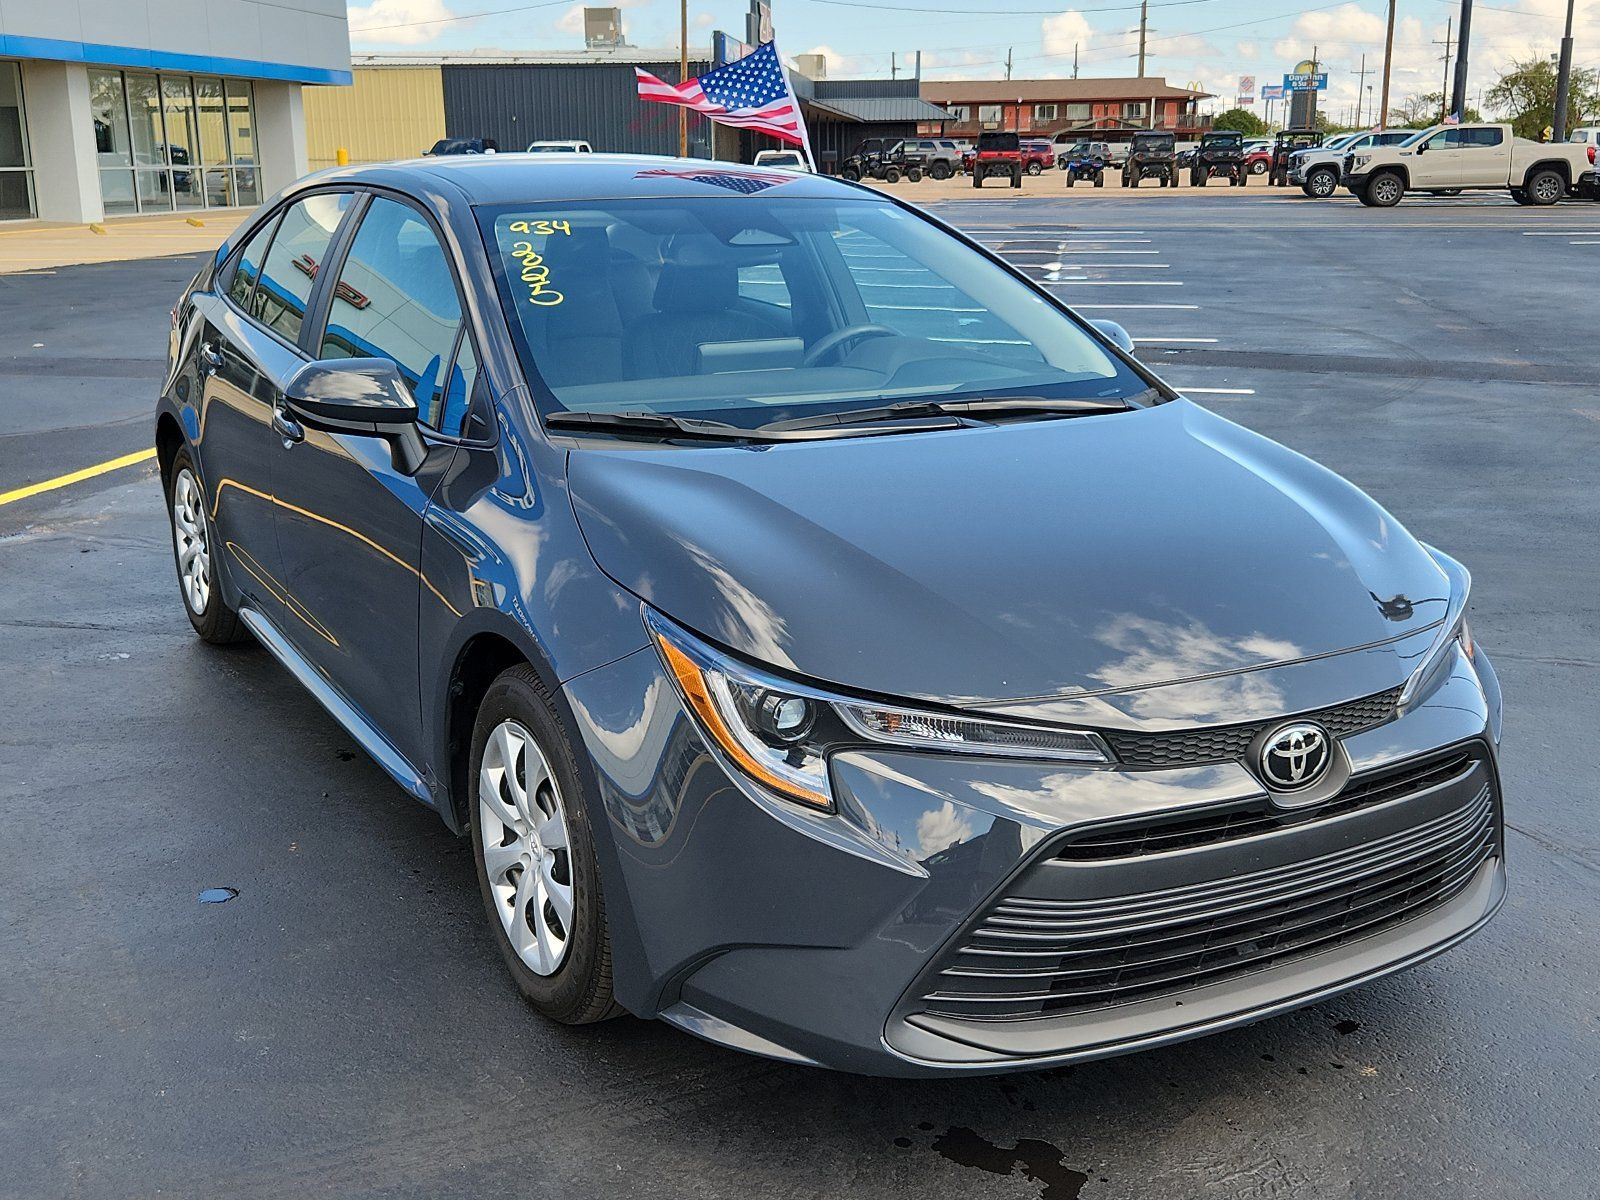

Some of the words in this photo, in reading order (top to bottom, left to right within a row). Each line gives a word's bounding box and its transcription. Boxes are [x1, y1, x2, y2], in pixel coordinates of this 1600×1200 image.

[1288, 74, 1309, 82] Days
[509, 219, 572, 236] 934
[511, 241, 564, 306] 2025
